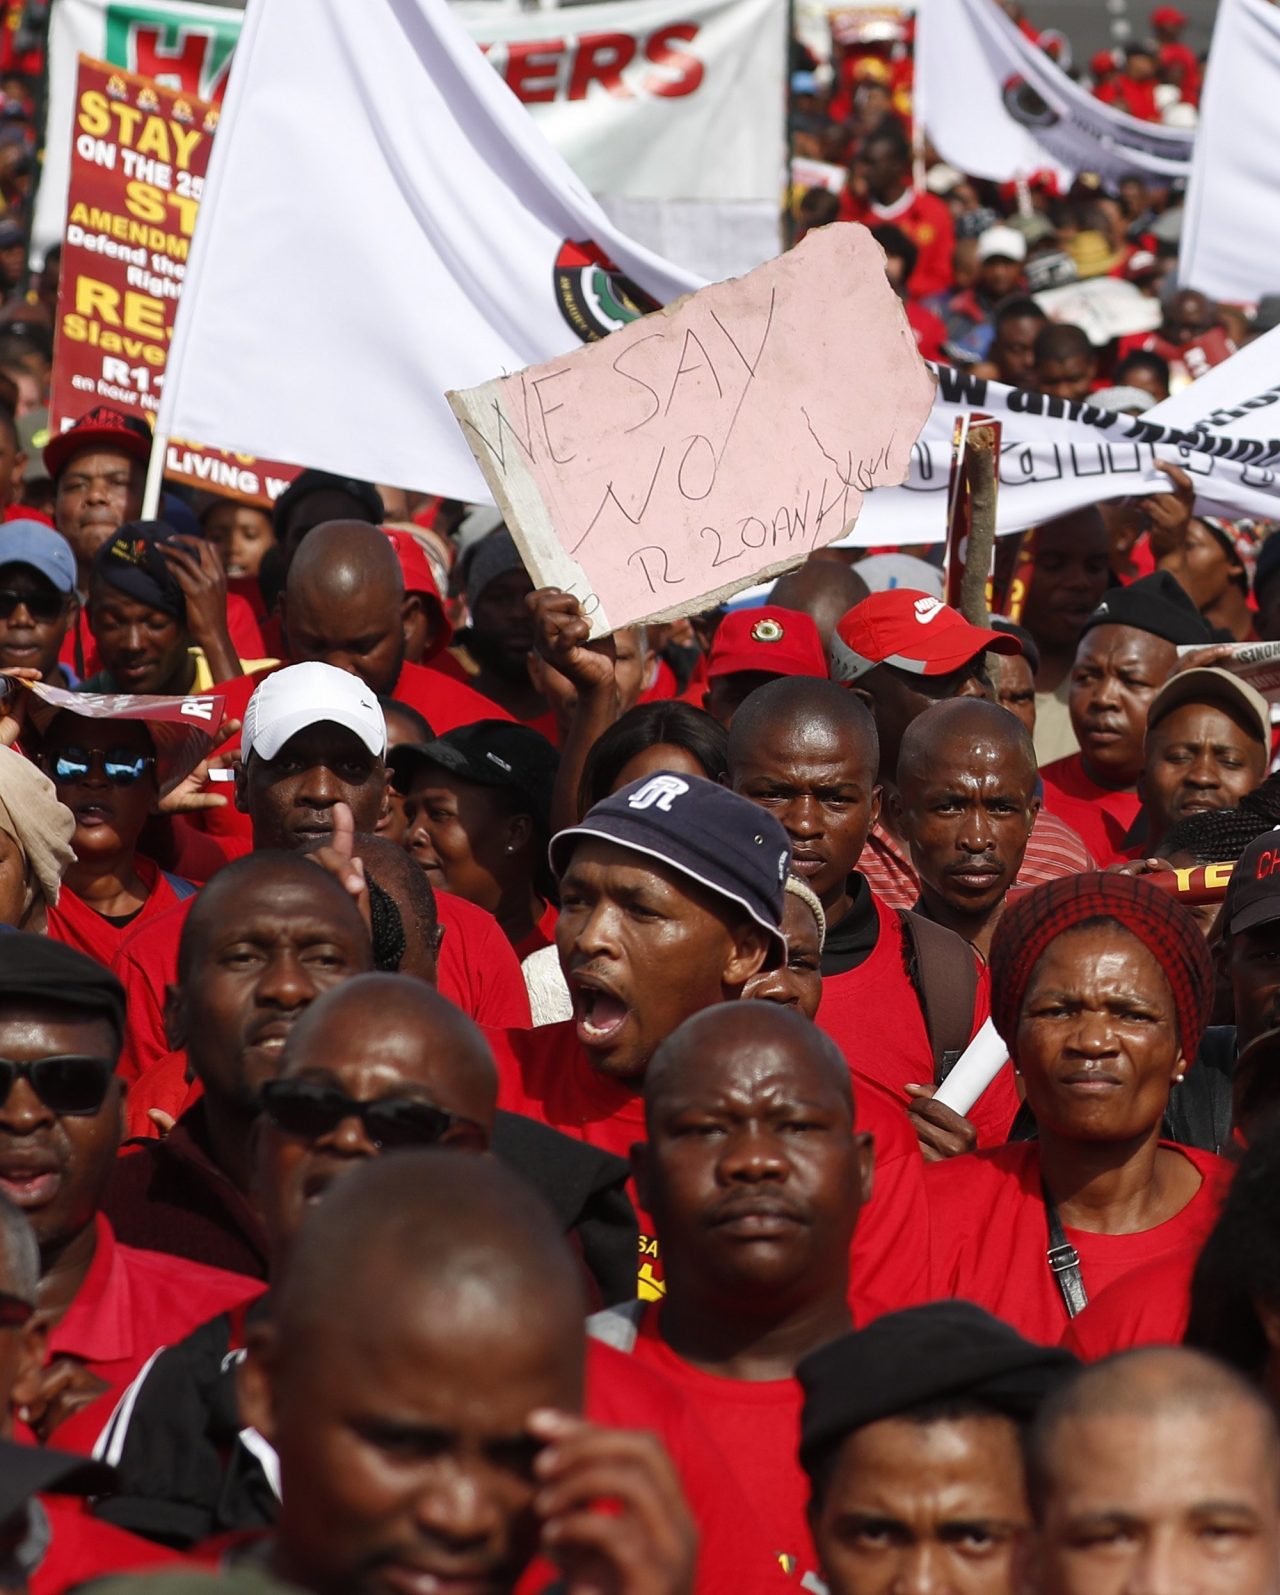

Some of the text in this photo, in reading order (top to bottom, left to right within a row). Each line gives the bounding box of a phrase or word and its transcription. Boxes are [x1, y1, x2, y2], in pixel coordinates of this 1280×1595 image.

[479, 22, 706, 103] ERS
[77, 134, 116, 170] ON
[121, 147, 173, 191] THE
[78, 90, 202, 170] STAY
[67, 224, 148, 267] Defend
[75, 274, 174, 342] RE
[72, 374, 95, 393] an
[98, 379, 138, 406] hour
[464, 287, 776, 476] WE SAY
[166, 447, 260, 495] LIVING
[572, 435, 719, 555] NO
